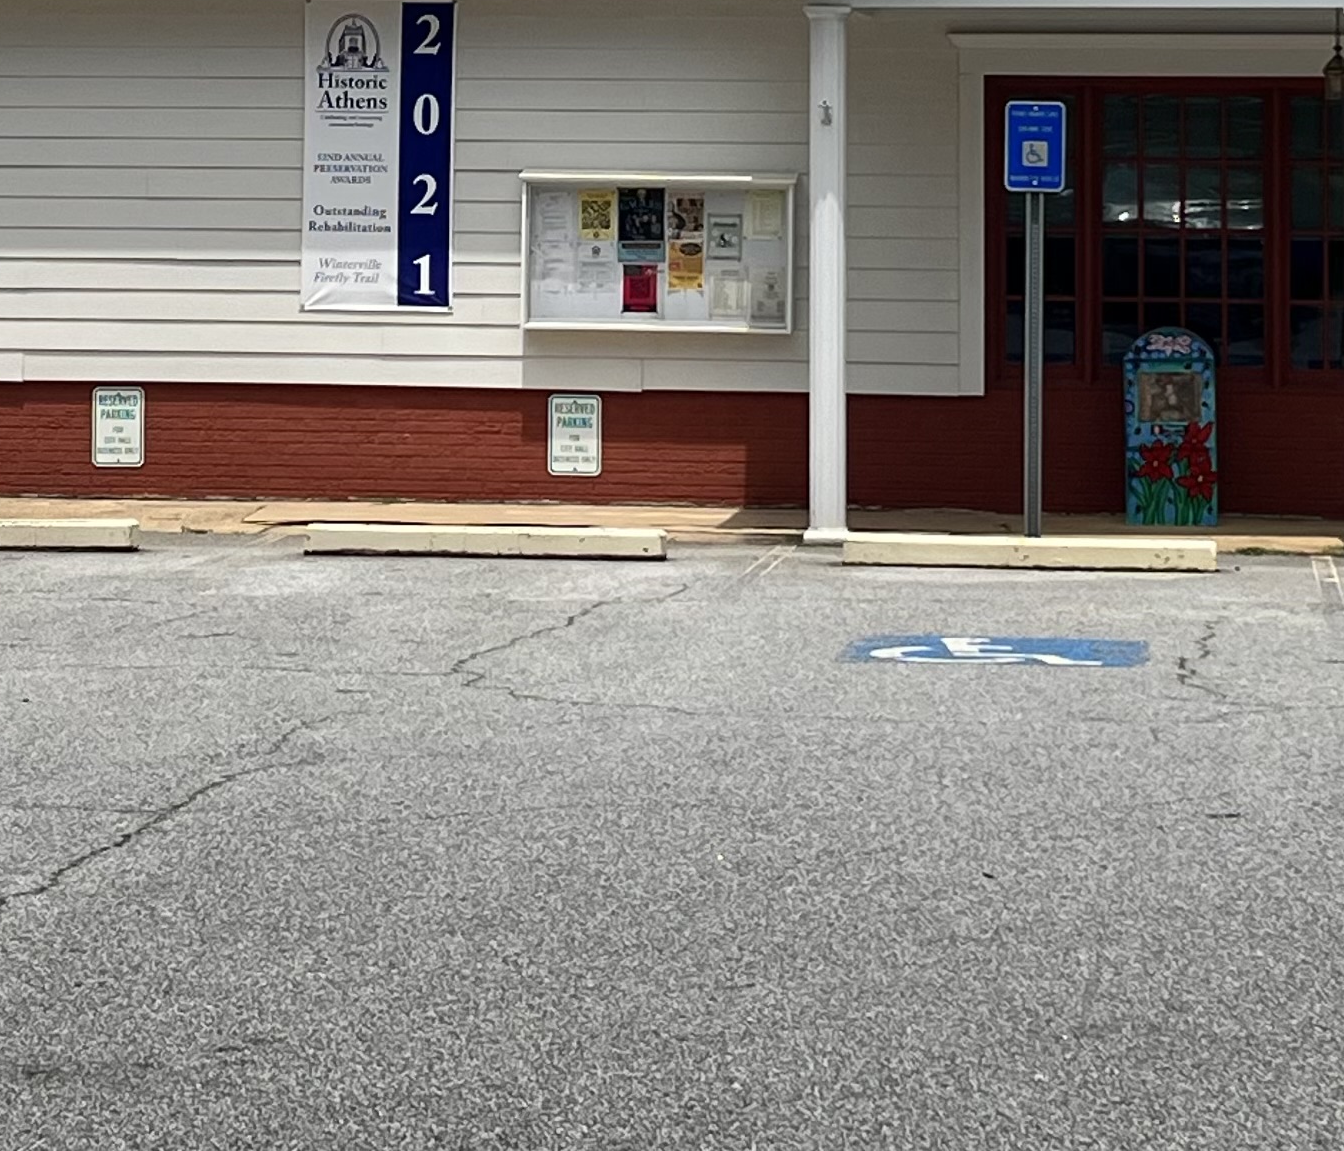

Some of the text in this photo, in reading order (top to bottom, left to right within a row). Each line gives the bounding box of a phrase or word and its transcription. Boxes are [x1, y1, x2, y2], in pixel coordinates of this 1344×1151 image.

[317, 72, 388, 90] Historic
[316, 90, 388, 110] Athens
[313, 204, 387, 220] Outstanding
[308, 220, 392, 233] Rehabilitation
[318, 257, 382, 270] Winterville
[313, 271, 380, 285] Firefly Trail
